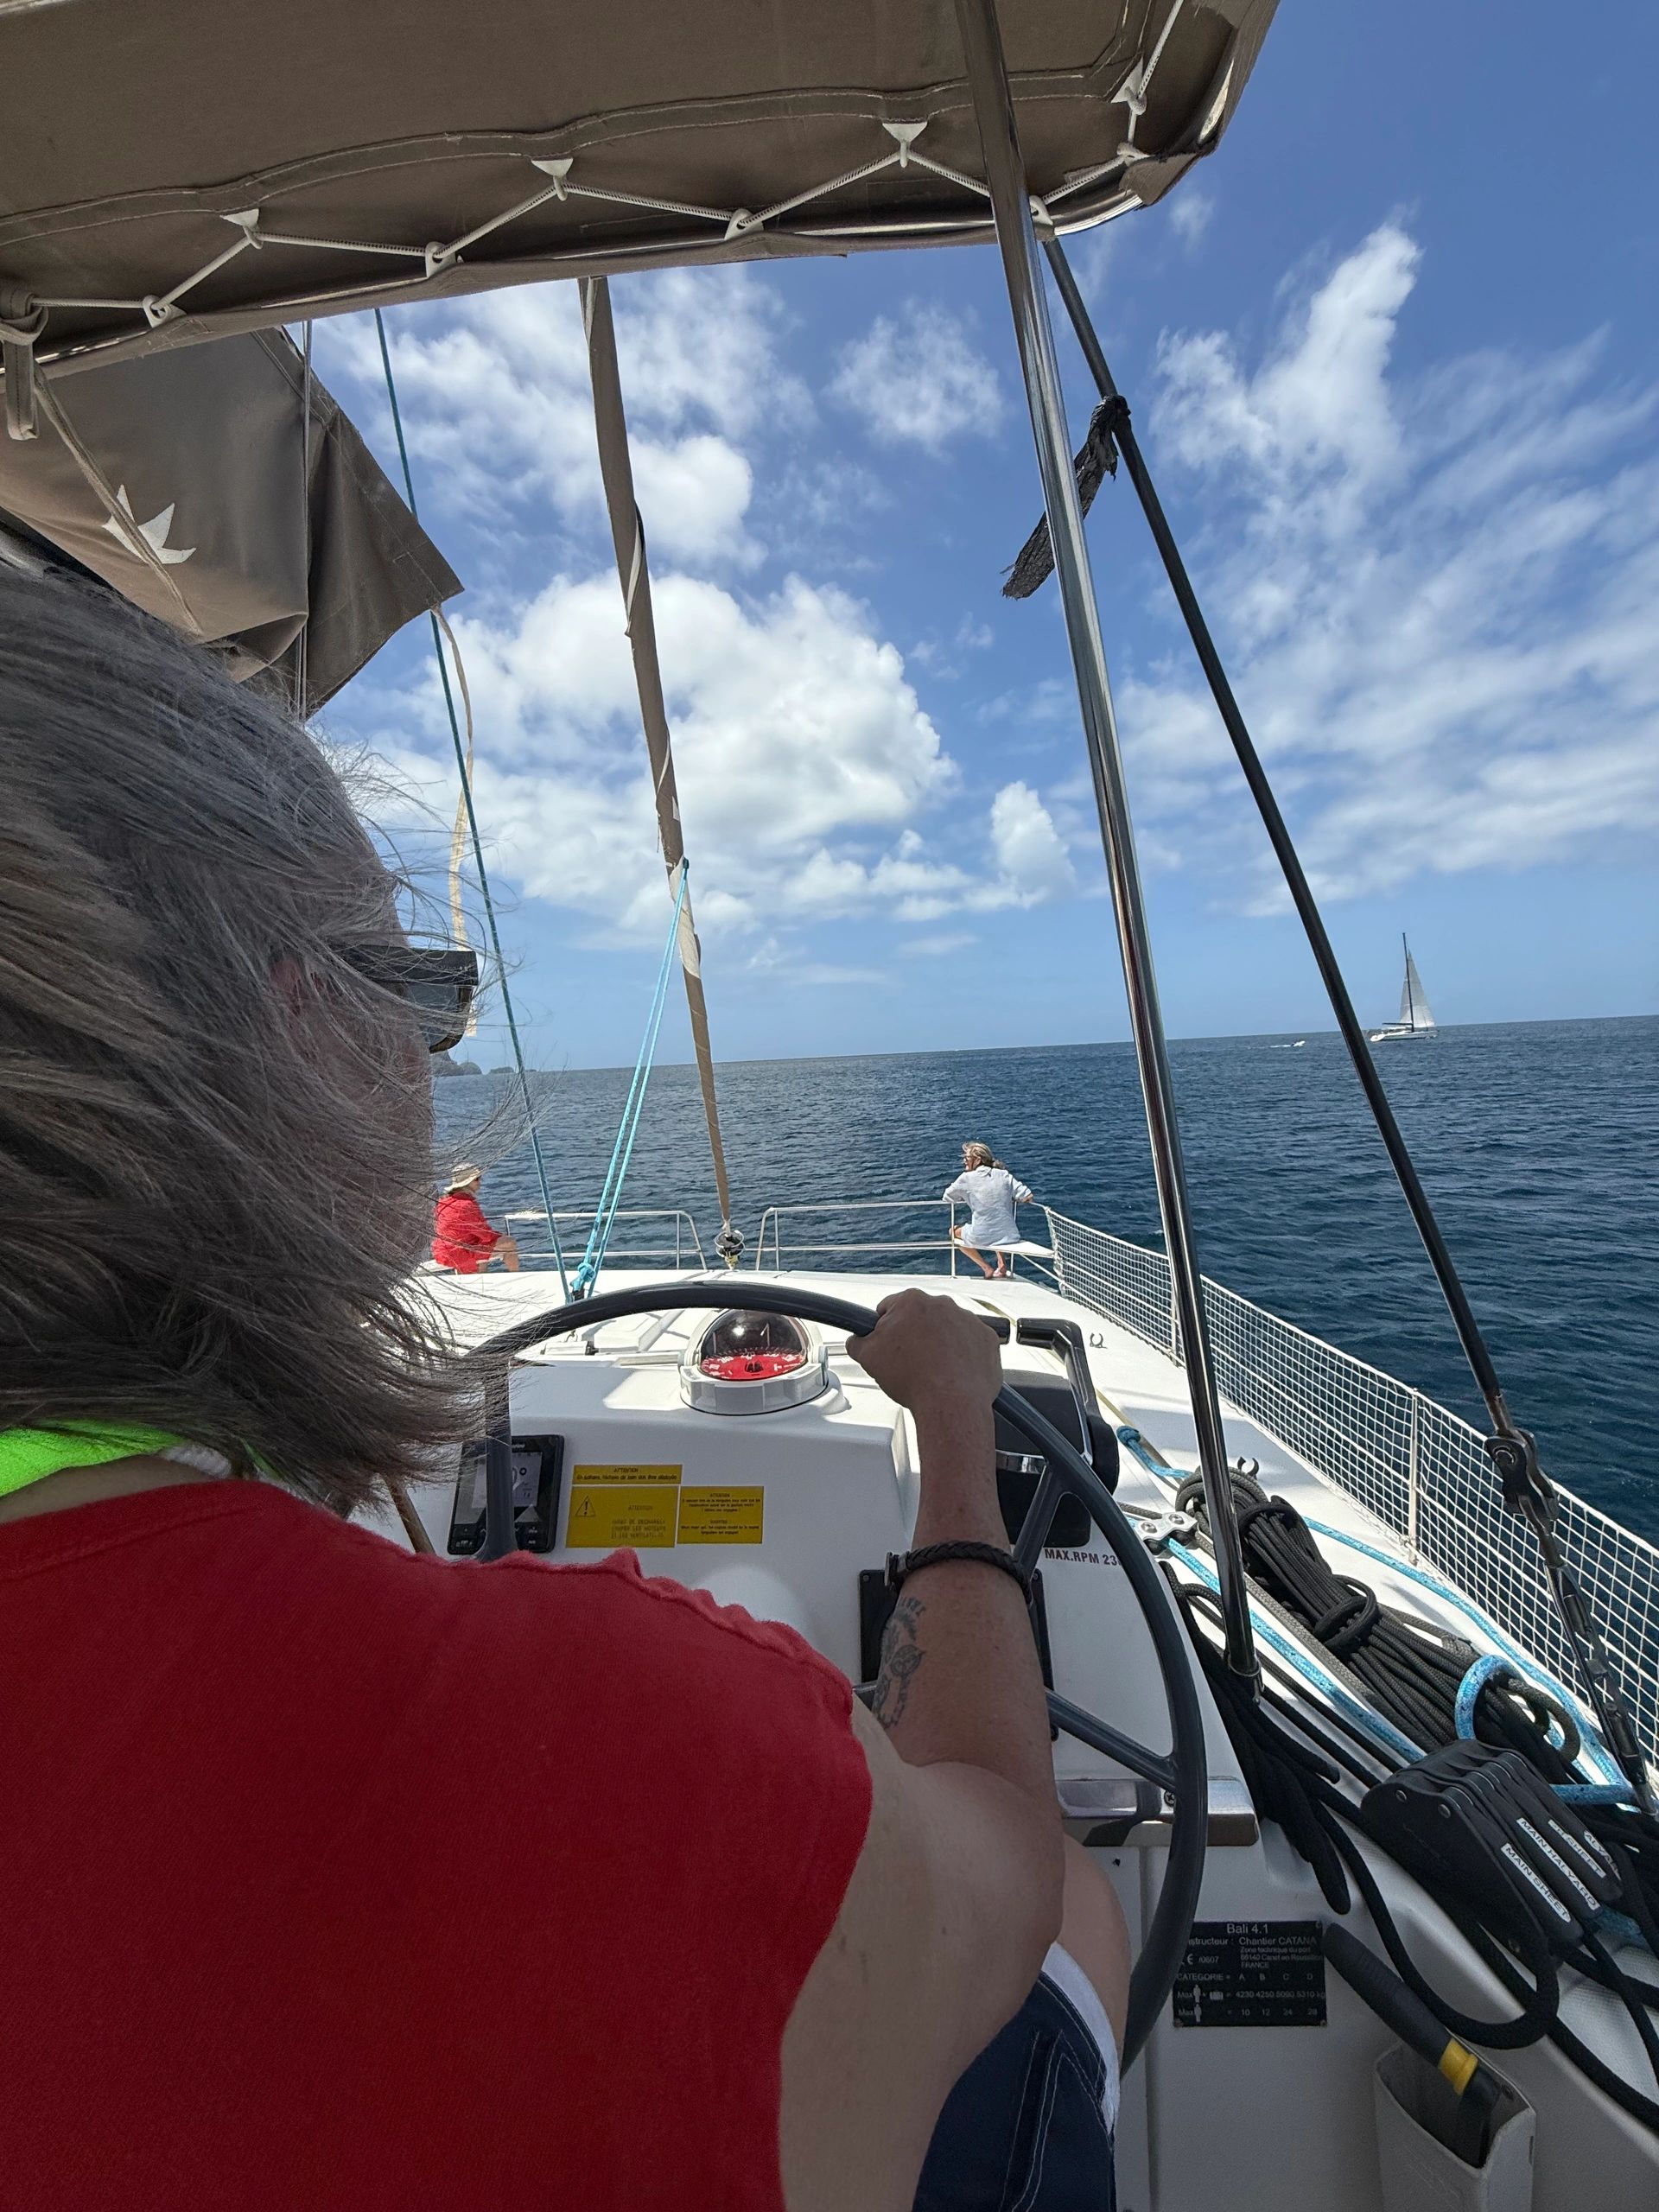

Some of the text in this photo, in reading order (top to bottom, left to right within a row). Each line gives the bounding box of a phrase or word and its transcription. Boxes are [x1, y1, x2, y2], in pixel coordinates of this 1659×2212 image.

[1044, 1548, 1122, 1566] MAX.RPM 23
[1521, 1820, 1548, 1848] MAIN
[1547, 1847, 1597, 1907] HALYARD
[1505, 1847, 1570, 1918] MAIN SHEET
[1226, 1923, 1268, 1935] Bali 4.1
[1238, 1936, 1276, 1946] Chantier
[1278, 1936, 1317, 1945] CATANA
[1238, 1973, 1246, 1981] A
